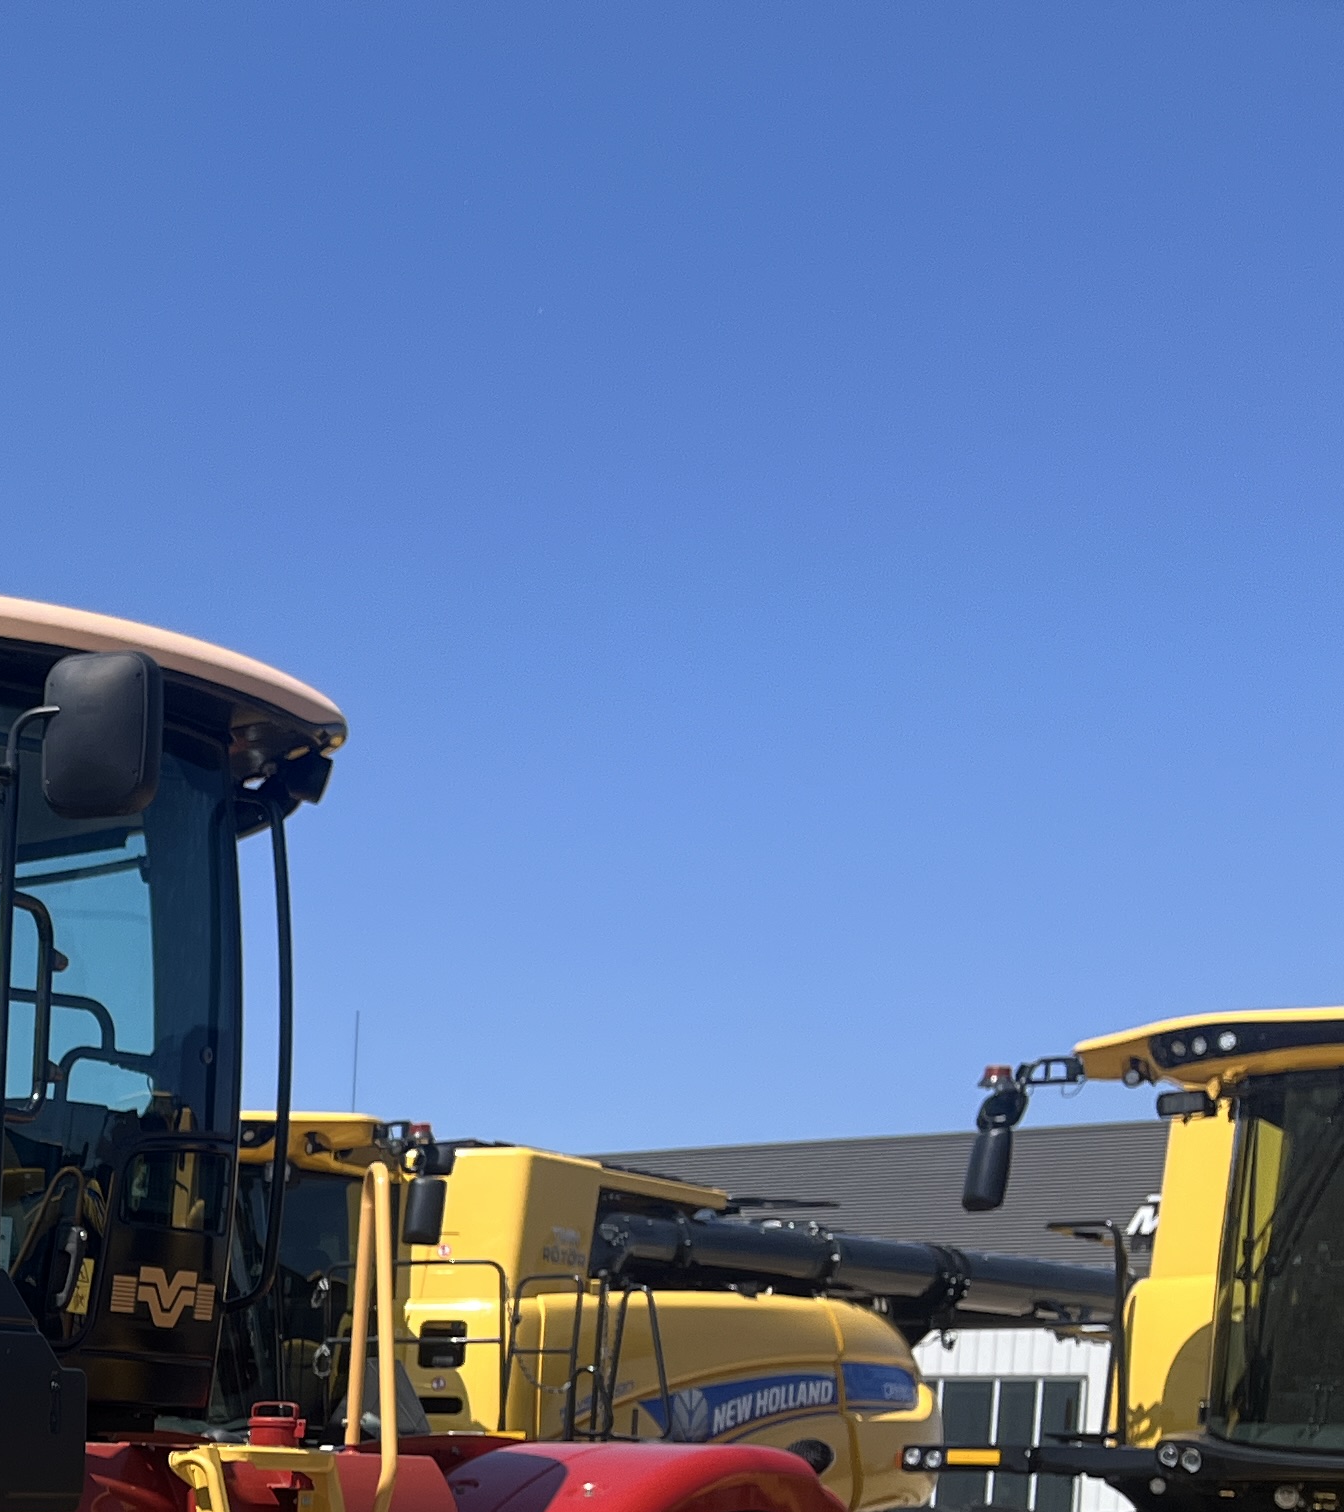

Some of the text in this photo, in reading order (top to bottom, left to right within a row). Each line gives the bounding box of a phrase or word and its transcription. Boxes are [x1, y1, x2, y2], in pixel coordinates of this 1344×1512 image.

[542, 1245, 586, 1267] ROTOR
[712, 1379, 834, 1436] NEW HOLLAND
